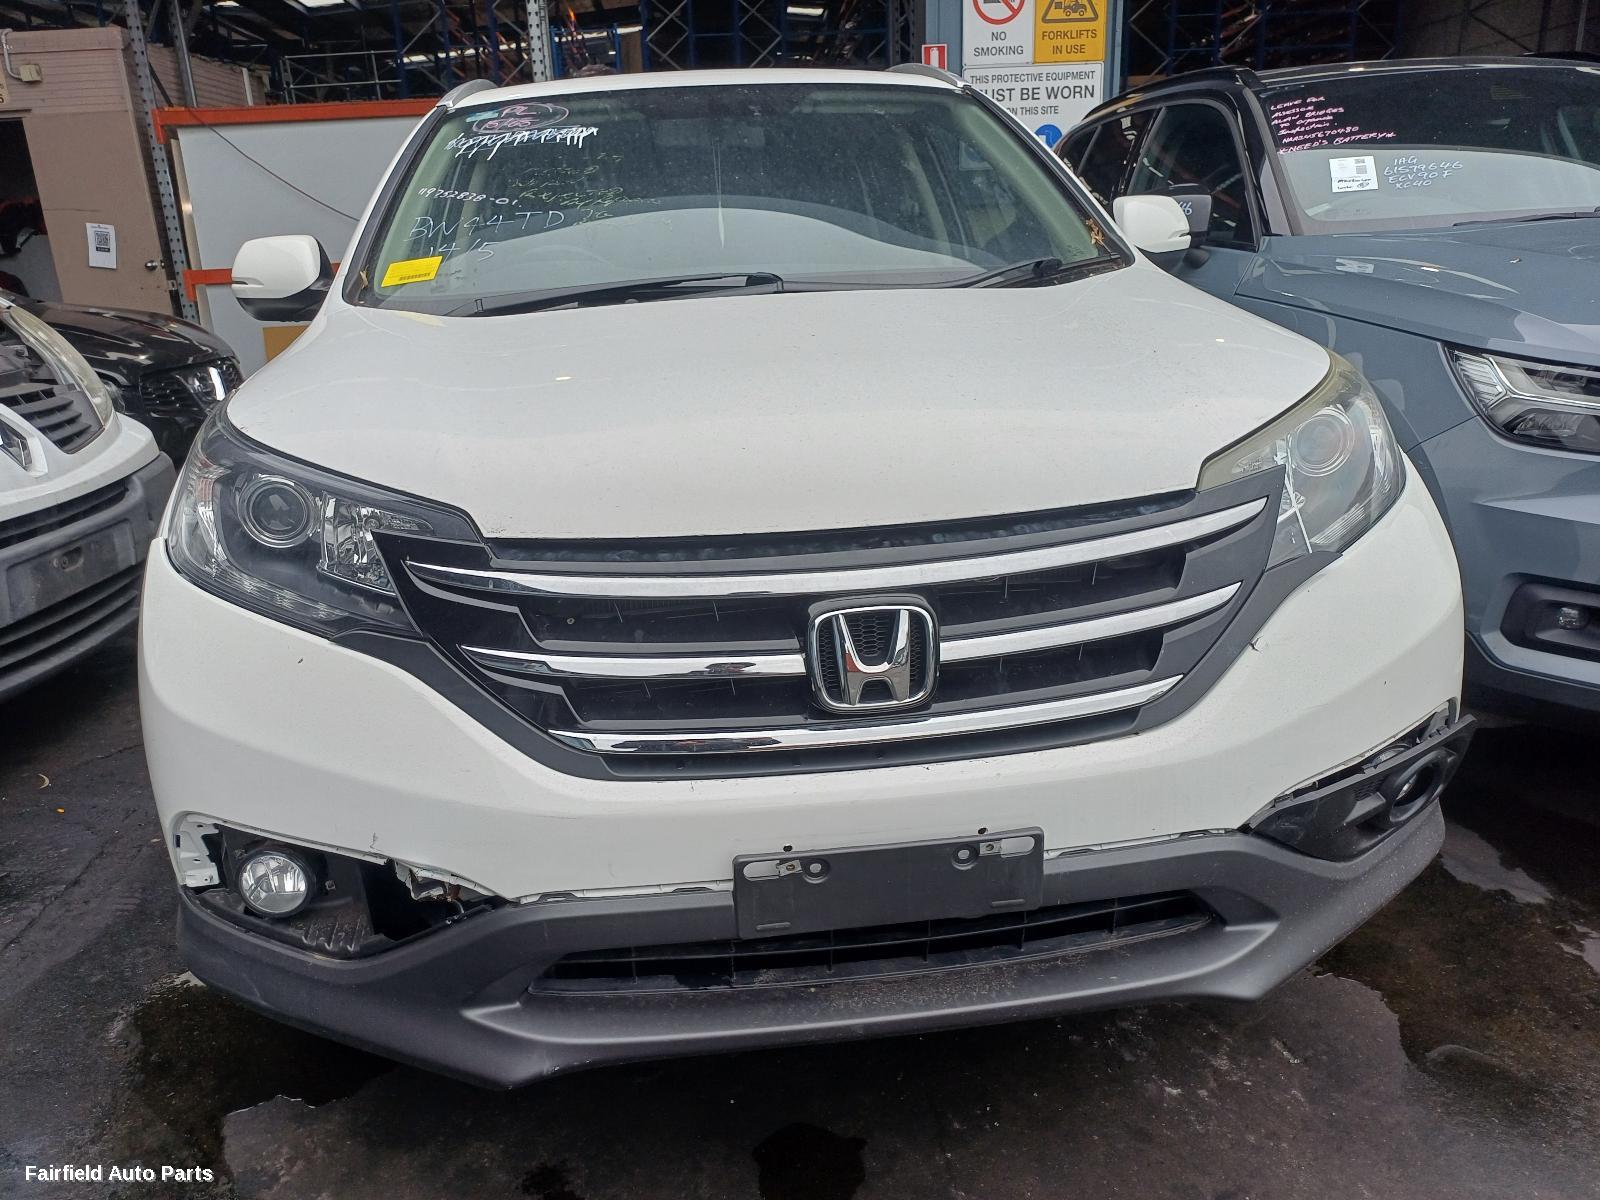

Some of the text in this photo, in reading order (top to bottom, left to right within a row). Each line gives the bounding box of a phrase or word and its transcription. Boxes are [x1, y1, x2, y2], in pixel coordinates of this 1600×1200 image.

[991, 31, 1007, 41] NO
[1041, 29, 1098, 41] FORKLIFTS
[973, 45, 1024, 57] SMOKING
[1052, 44, 1086, 55] IN USE
[970, 70, 1096, 84] THIS PROTECTIVE EQUIPMENT
[1020, 87, 1041, 101] BE
[1044, 84, 1095, 100] WORN
[1019, 106, 1039, 116] THIS
[1040, 105, 1059, 115] SITE
